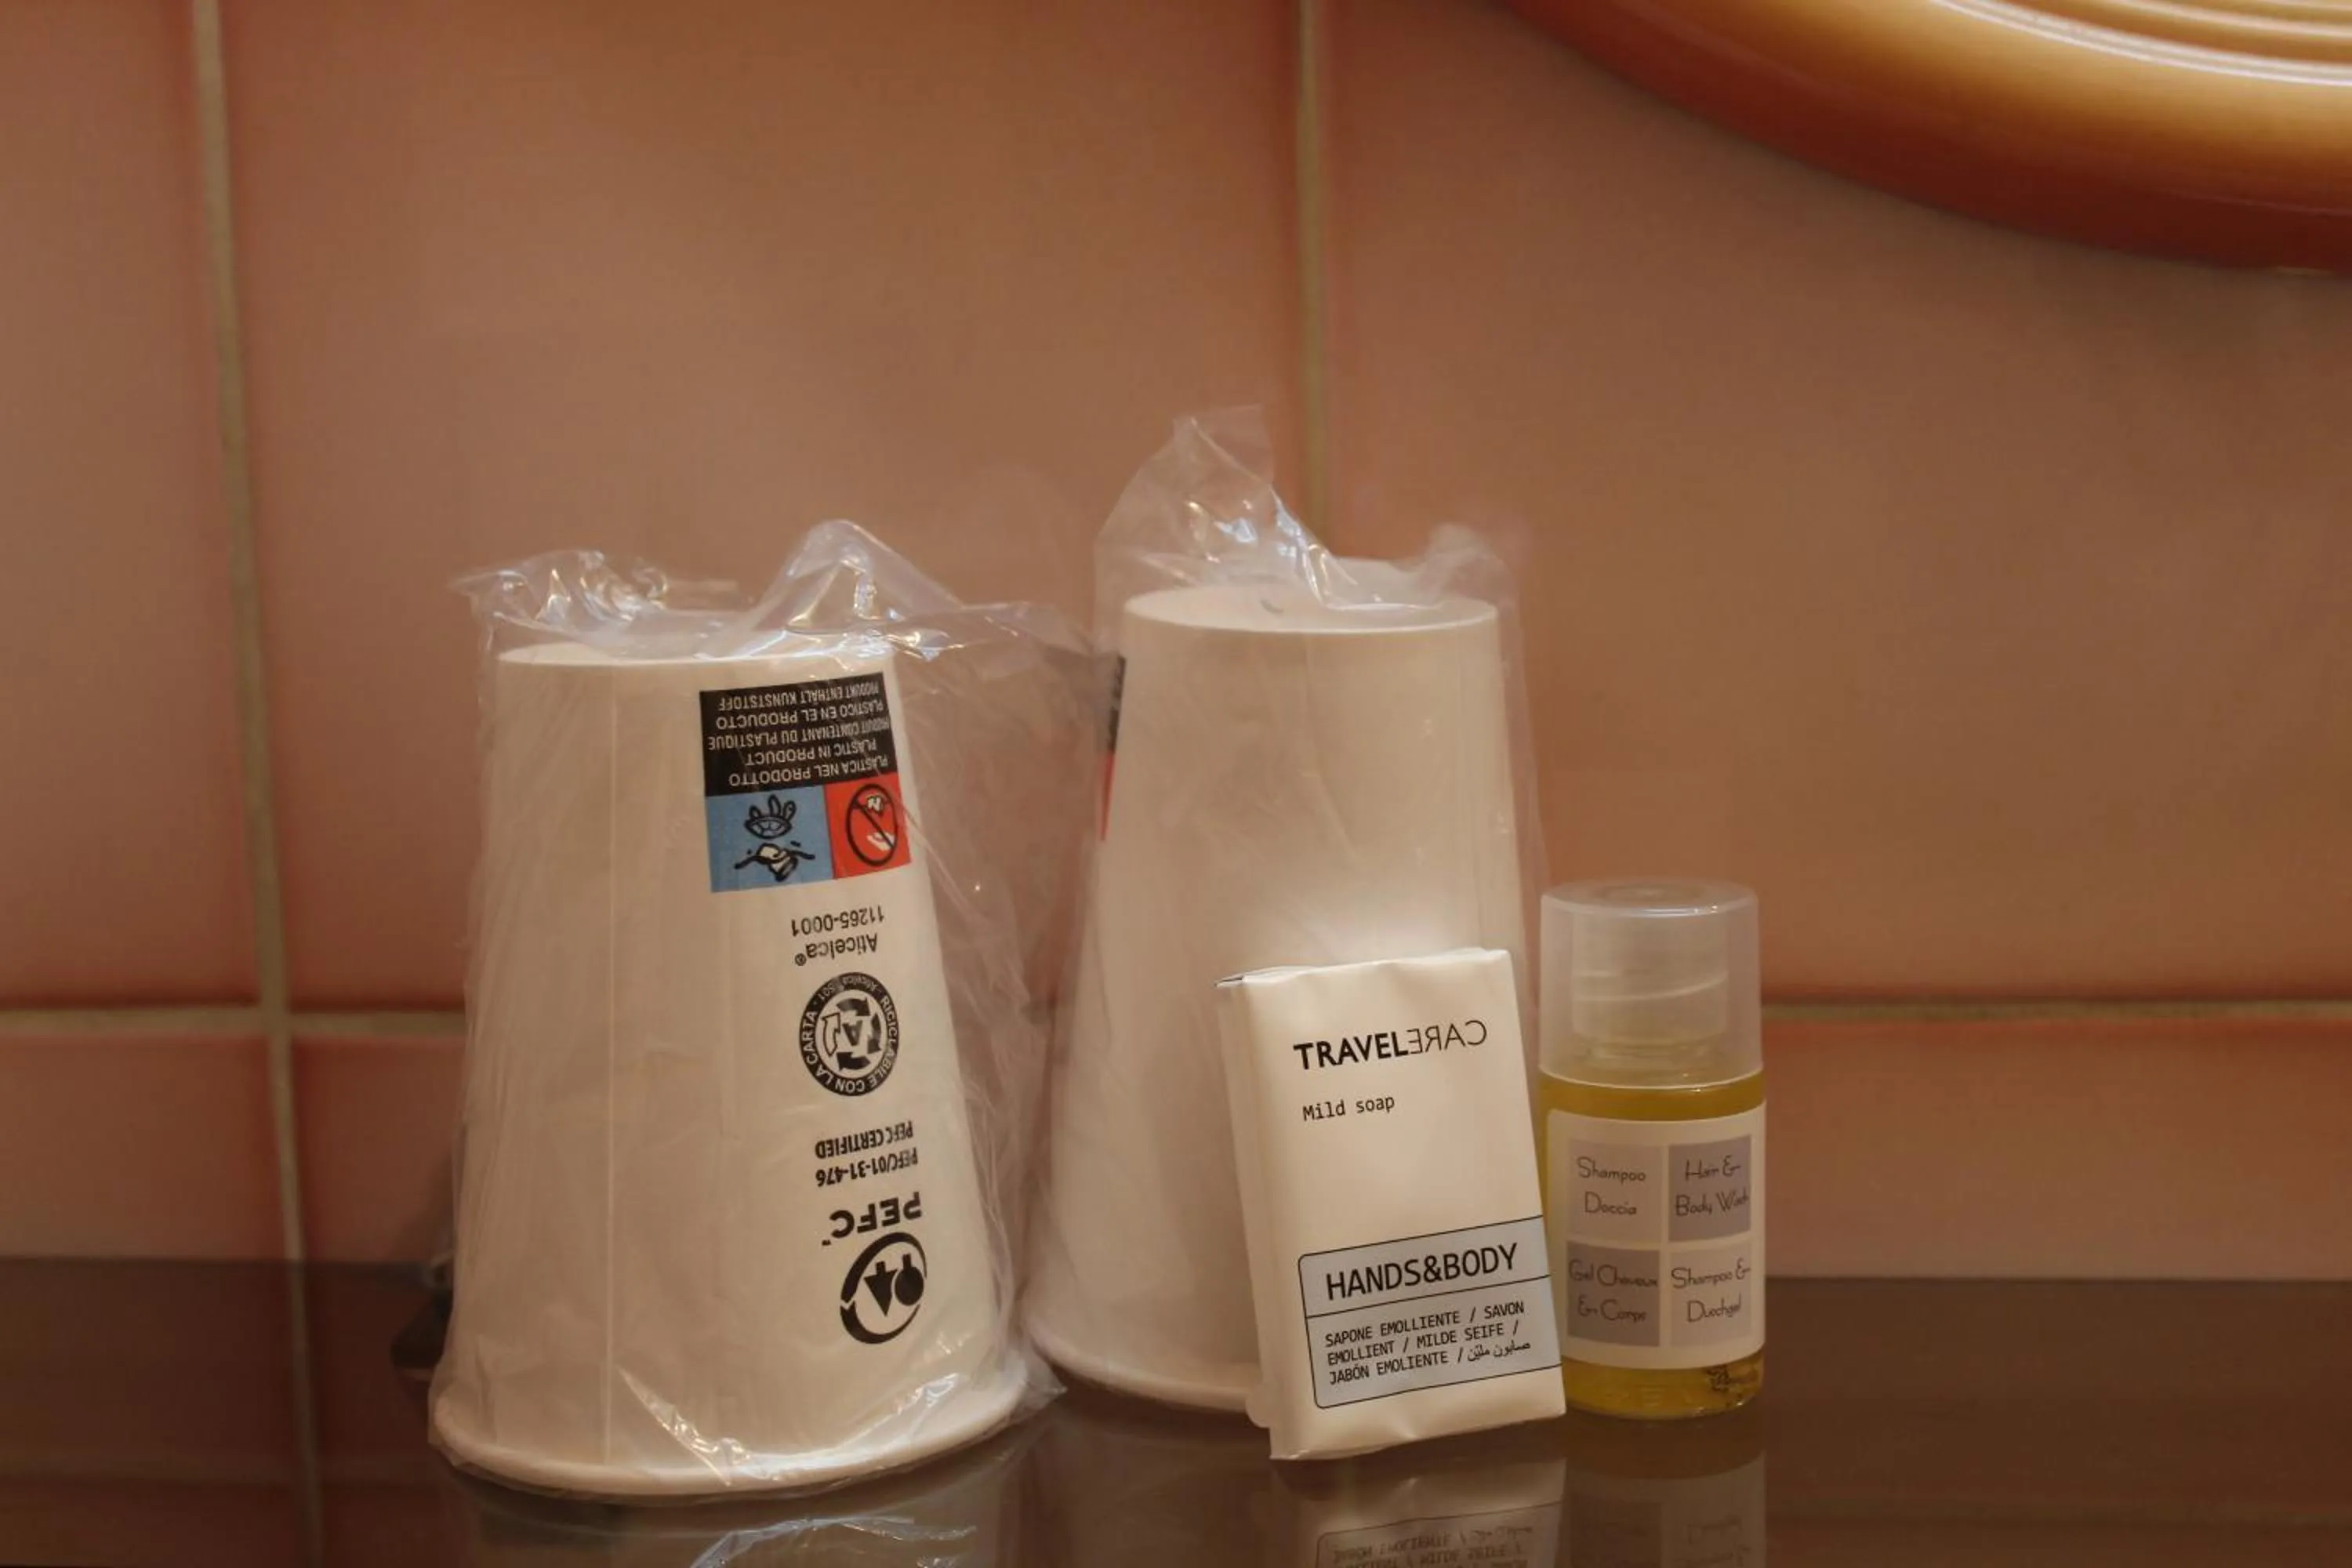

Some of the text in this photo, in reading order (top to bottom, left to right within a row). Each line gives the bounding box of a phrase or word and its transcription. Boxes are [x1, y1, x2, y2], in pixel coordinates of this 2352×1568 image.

[718, 690, 797, 711] KUNSTSTOFF
[821, 706, 837, 720] EN
[716, 711, 798, 730] PRODUCTO
[803, 708, 818, 721] EL
[708, 731, 779, 750] PLASTIQUE
[782, 729, 798, 742] DU
[801, 722, 860, 742] CONTENANT
[746, 739, 877, 766] PLASTIC IN PRODUCT
[728, 753, 888, 787] PLASTICA NEL PRODOTTO
[790, 905, 884, 937] 11265-0001
[801, 1010, 820, 1065] CARTA
[814, 1065, 833, 1086] LA
[835, 1079, 865, 1094] CON
[1302, 1096, 1396, 1121] Mild soap
[815, 1120, 913, 1160] PEFC CERTIFIED
[815, 1147, 918, 1188] PEFC/01-31-476
[1577, 1156, 1646, 1186] Shampoo
[1584, 1190, 1637, 1215] Doccia
[1675, 1193, 1713, 1217] Body
[1326, 1242, 1518, 1301] HANDS&BODY
[1671, 1266, 1733, 1290] Shampoo
[1325, 1326, 1374, 1348] SAPONE
[1380, 1310, 1461, 1336] EMOLLIENTE
[1483, 1300, 1525, 1319] SAVON
[1327, 1340, 1395, 1366] EMOLLIENT
[1416, 1330, 1457, 1349] MILDE
[1464, 1322, 1504, 1341] SEIFE
[1329, 1363, 1370, 1385] JABÓN
[1376, 1350, 1449, 1376] EMOLIENTE
